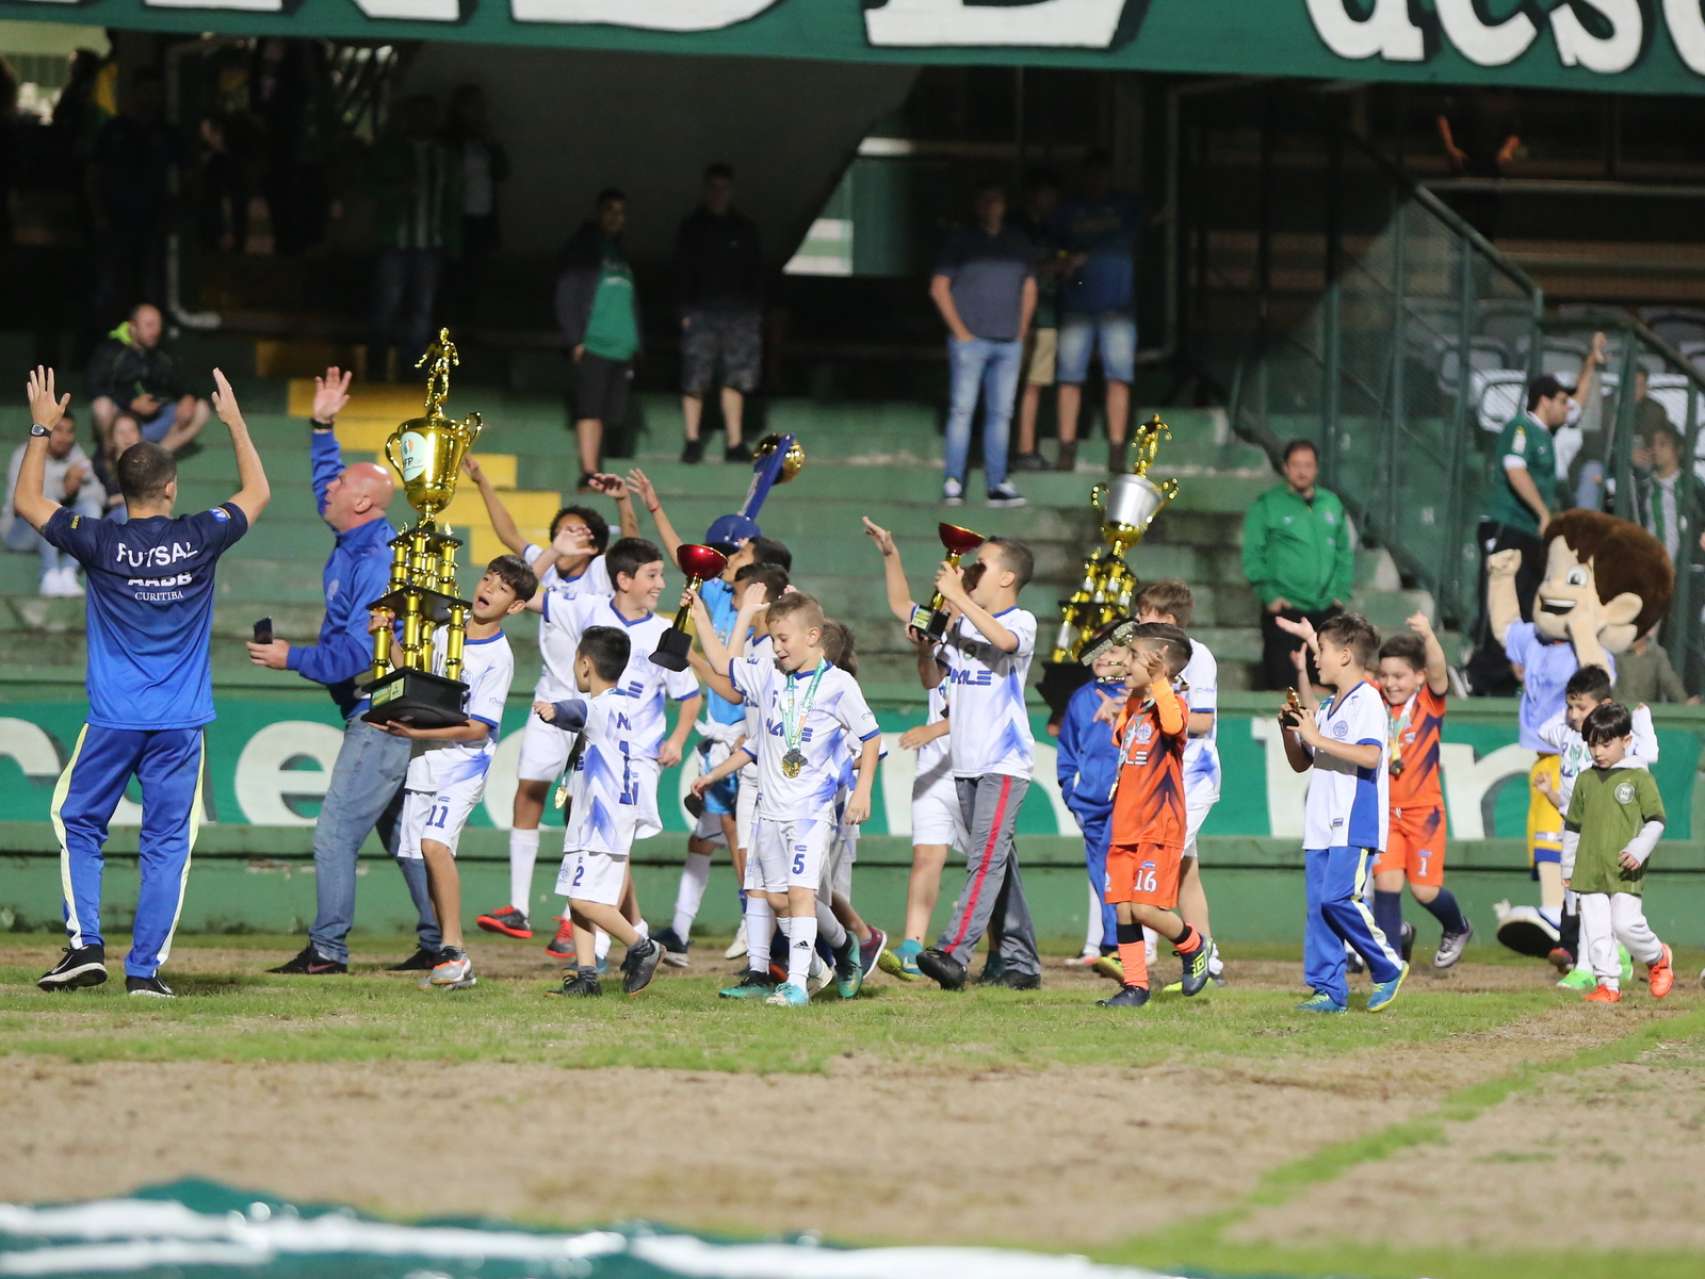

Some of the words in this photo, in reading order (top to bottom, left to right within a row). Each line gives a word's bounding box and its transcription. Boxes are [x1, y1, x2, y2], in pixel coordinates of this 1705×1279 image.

[116, 542, 198, 567] FUTSAL
[135, 591, 184, 601] CURITIBA
[425, 804, 449, 829] 11
[792, 853, 806, 875] 5
[572, 865, 585, 887] 2
[1134, 869, 1158, 893] 16
